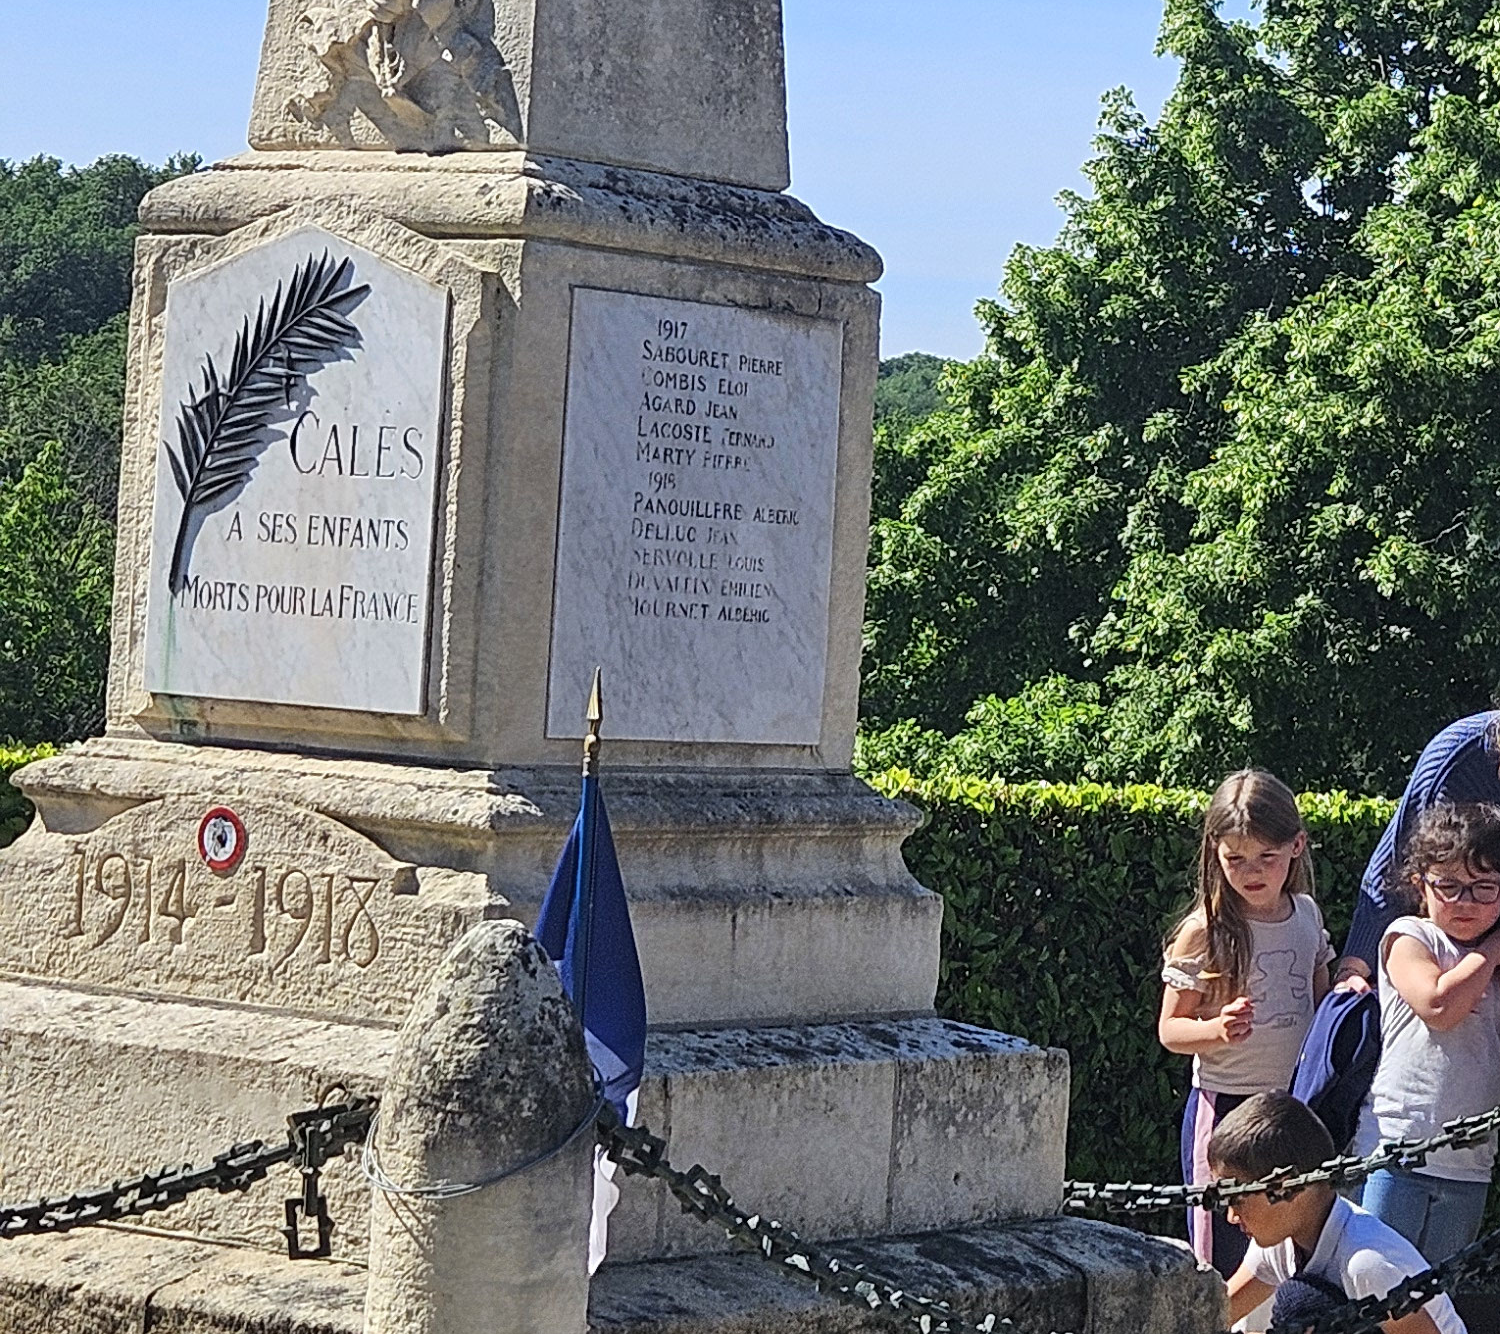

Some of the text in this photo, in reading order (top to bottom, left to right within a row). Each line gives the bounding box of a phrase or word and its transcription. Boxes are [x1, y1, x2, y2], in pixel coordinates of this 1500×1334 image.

[657, 319, 689, 341] 1917
[642, 339, 784, 376] SABOURET PIERRE
[718, 378, 749, 397] ELOI
[639, 391, 738, 420] AGARD JEAN
[636, 415, 712, 444] LACOSTE
[636, 441, 697, 466] MARTY
[648, 471, 677, 493] 1918
[257, 512, 298, 544] SES
[307, 515, 410, 550] ENFANTS
[728, 553, 765, 573] LOUIS
[180, 574, 419, 624] MORTS POUR LA FRANCE
